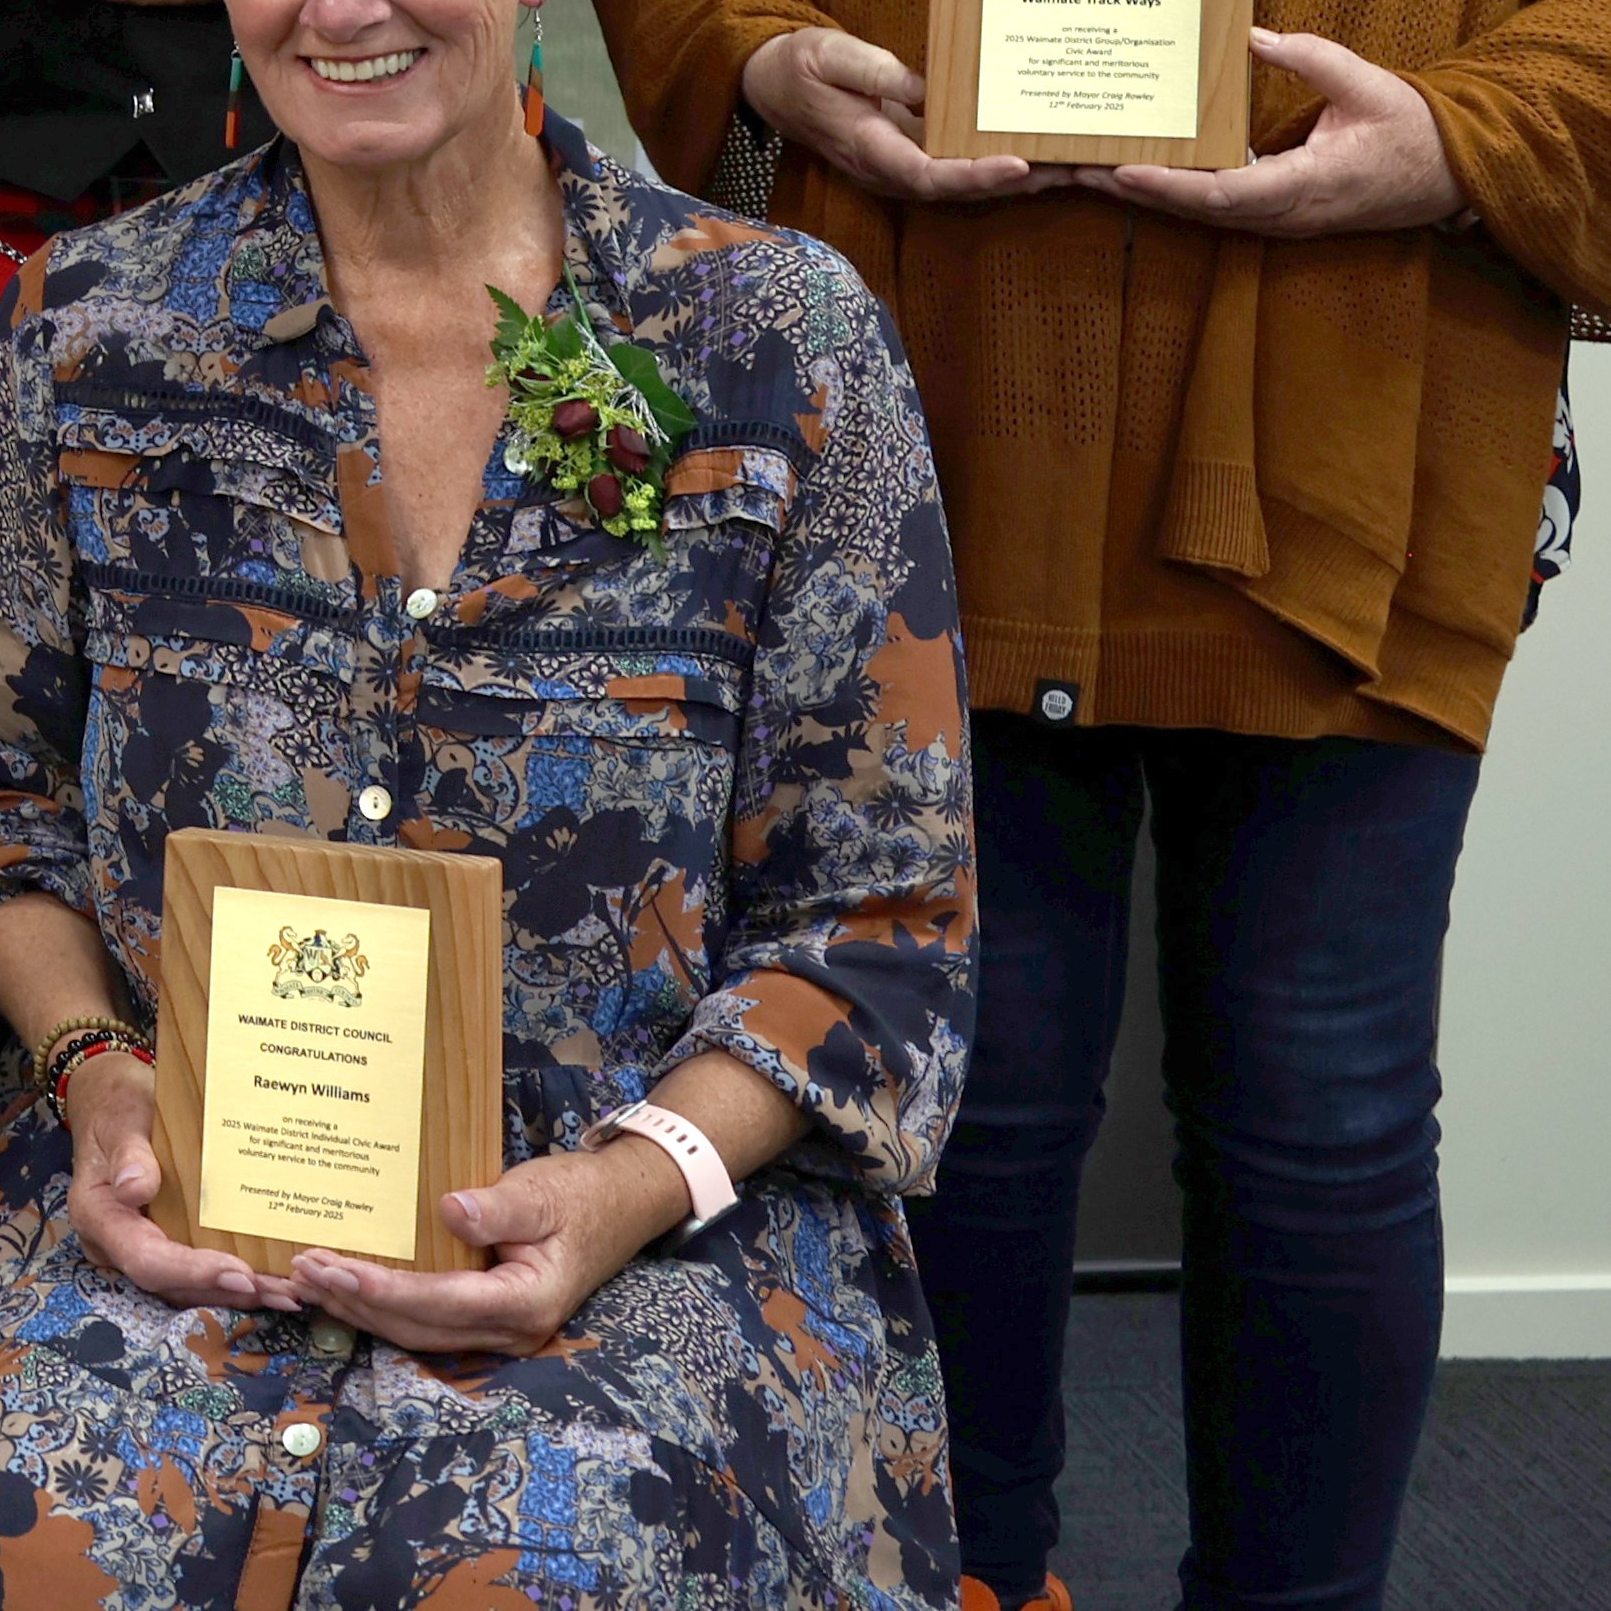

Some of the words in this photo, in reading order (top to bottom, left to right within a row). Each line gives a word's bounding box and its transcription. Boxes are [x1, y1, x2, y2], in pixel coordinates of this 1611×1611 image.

[1074, 27, 1111, 35] receiving
[1095, 37, 1176, 47] Group/Organisation
[1065, 47, 1083, 55] Civic
[1086, 48, 1112, 56] Award
[1028, 57, 1040, 65] for
[1042, 58, 1082, 67] significant
[1084, 59, 1100, 67] and
[1102, 60, 1149, 68] meritorious
[1017, 68, 1055, 77] voluntary
[1113, 72, 1160, 81] community
[1020, 89, 1060, 97] Presented
[1073, 91, 1100, 99] Mayor
[1066, 101, 1102, 111] February
[1104, 102, 1124, 111] 2025
[238, 1014, 287, 1030] WAIMATE
[290, 1021, 340, 1036] DISTRICT
[343, 1028, 392, 1044] COUNCIL
[259, 1042, 368, 1066] CONGRATULATIONS
[254, 1075, 307, 1096] Raewyn
[311, 1083, 370, 1103] Williams
[282, 1116, 293, 1124] on
[295, 1118, 331, 1131] receiving
[222, 1119, 241, 1129] 2025
[243, 1122, 278, 1135] Waimate
[281, 1127, 309, 1139] District
[311, 1132, 351, 1145] Individual
[352, 1138, 371, 1148] Civic
[373, 1141, 400, 1153] Award
[249, 1135, 261, 1144] for
[263, 1139, 303, 1151] significant
[305, 1145, 321, 1154] and
[322, 1148, 370, 1161] meritorious
[238, 1148, 276, 1161] voluntary
[277, 1154, 306, 1165] service
[307, 1157, 316, 1166] to
[318, 1159, 332, 1168] the
[333, 1162, 380, 1177] community
[240, 1184, 280, 1198] Presented
[281, 1190, 291, 1200] by
[292, 1192, 320, 1203] Mayor
[321, 1197, 343, 1209] Craig
[344, 1200, 374, 1213] Rowley
[285, 1203, 322, 1218] February
[323, 1209, 344, 1220] 2025
